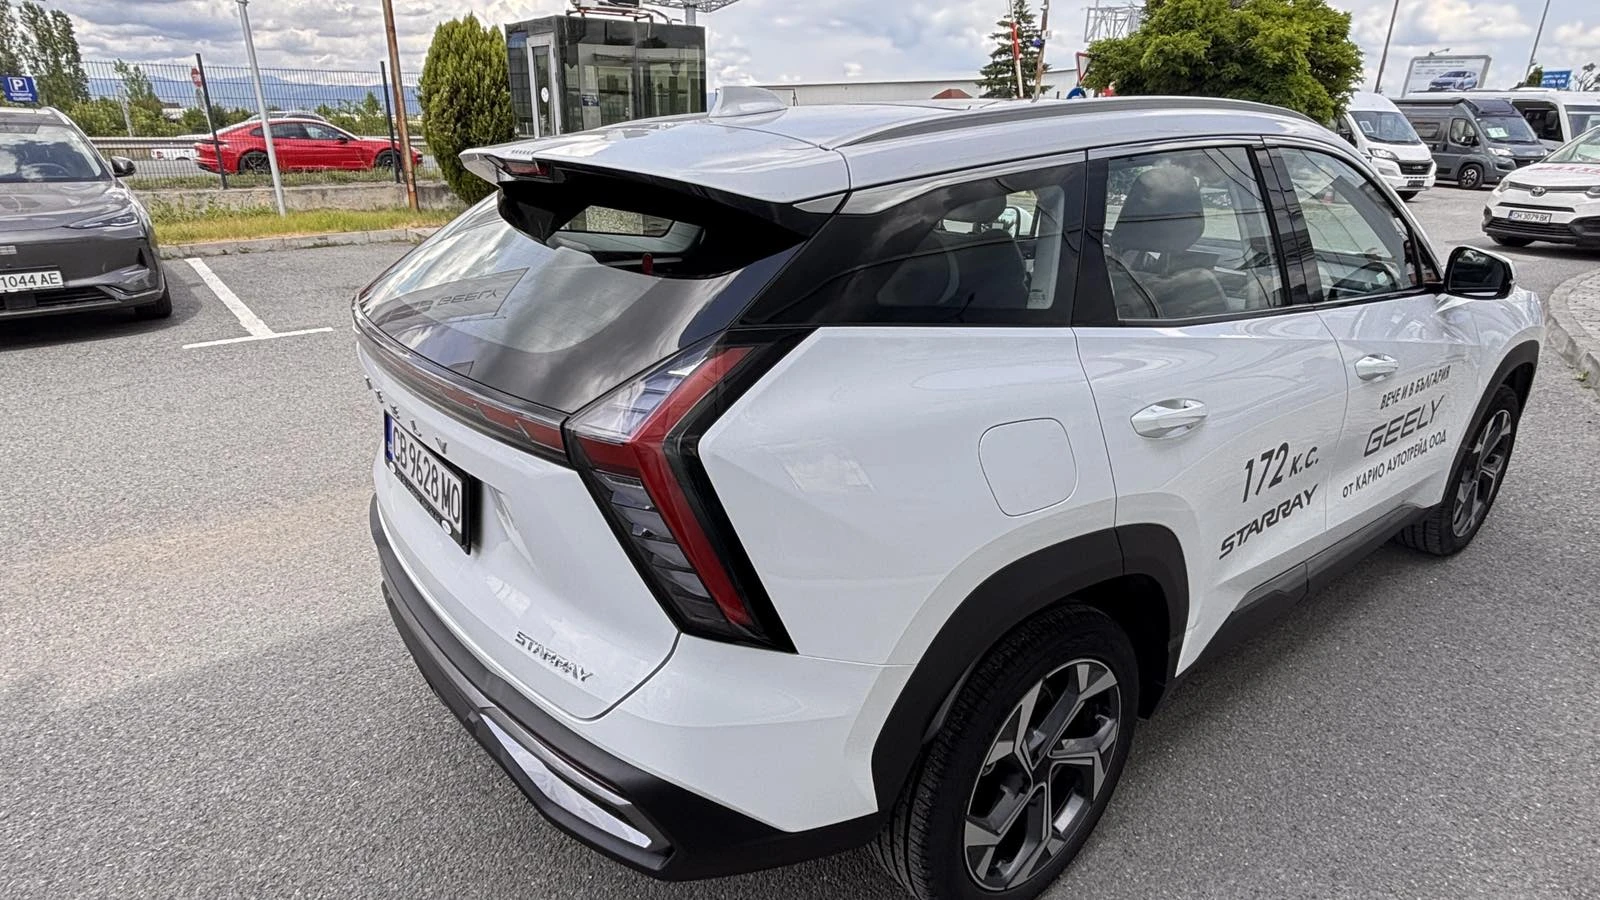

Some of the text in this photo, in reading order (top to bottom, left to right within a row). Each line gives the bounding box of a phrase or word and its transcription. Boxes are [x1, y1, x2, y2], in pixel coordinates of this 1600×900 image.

[12, 79, 24, 91] P
[0, 272, 61, 288] 1044 AE
[1380, 365, 1451, 410] ВЕЧЕ И В БЪЛГАРИЯ
[1363, 394, 1445, 457] GEELY
[392, 426, 408, 470] CB
[409, 442, 439, 503] 9628
[441, 472, 461, 525] MO
[1242, 442, 1289, 503] 172
[1355, 462, 1385, 492] КАРИО
[1386, 438, 1428, 474] АУТОТРЕЙД
[1429, 429, 1447, 449] ООД
[1218, 483, 1319, 560] STARRAY
[514, 630, 594, 682] STARRAY
